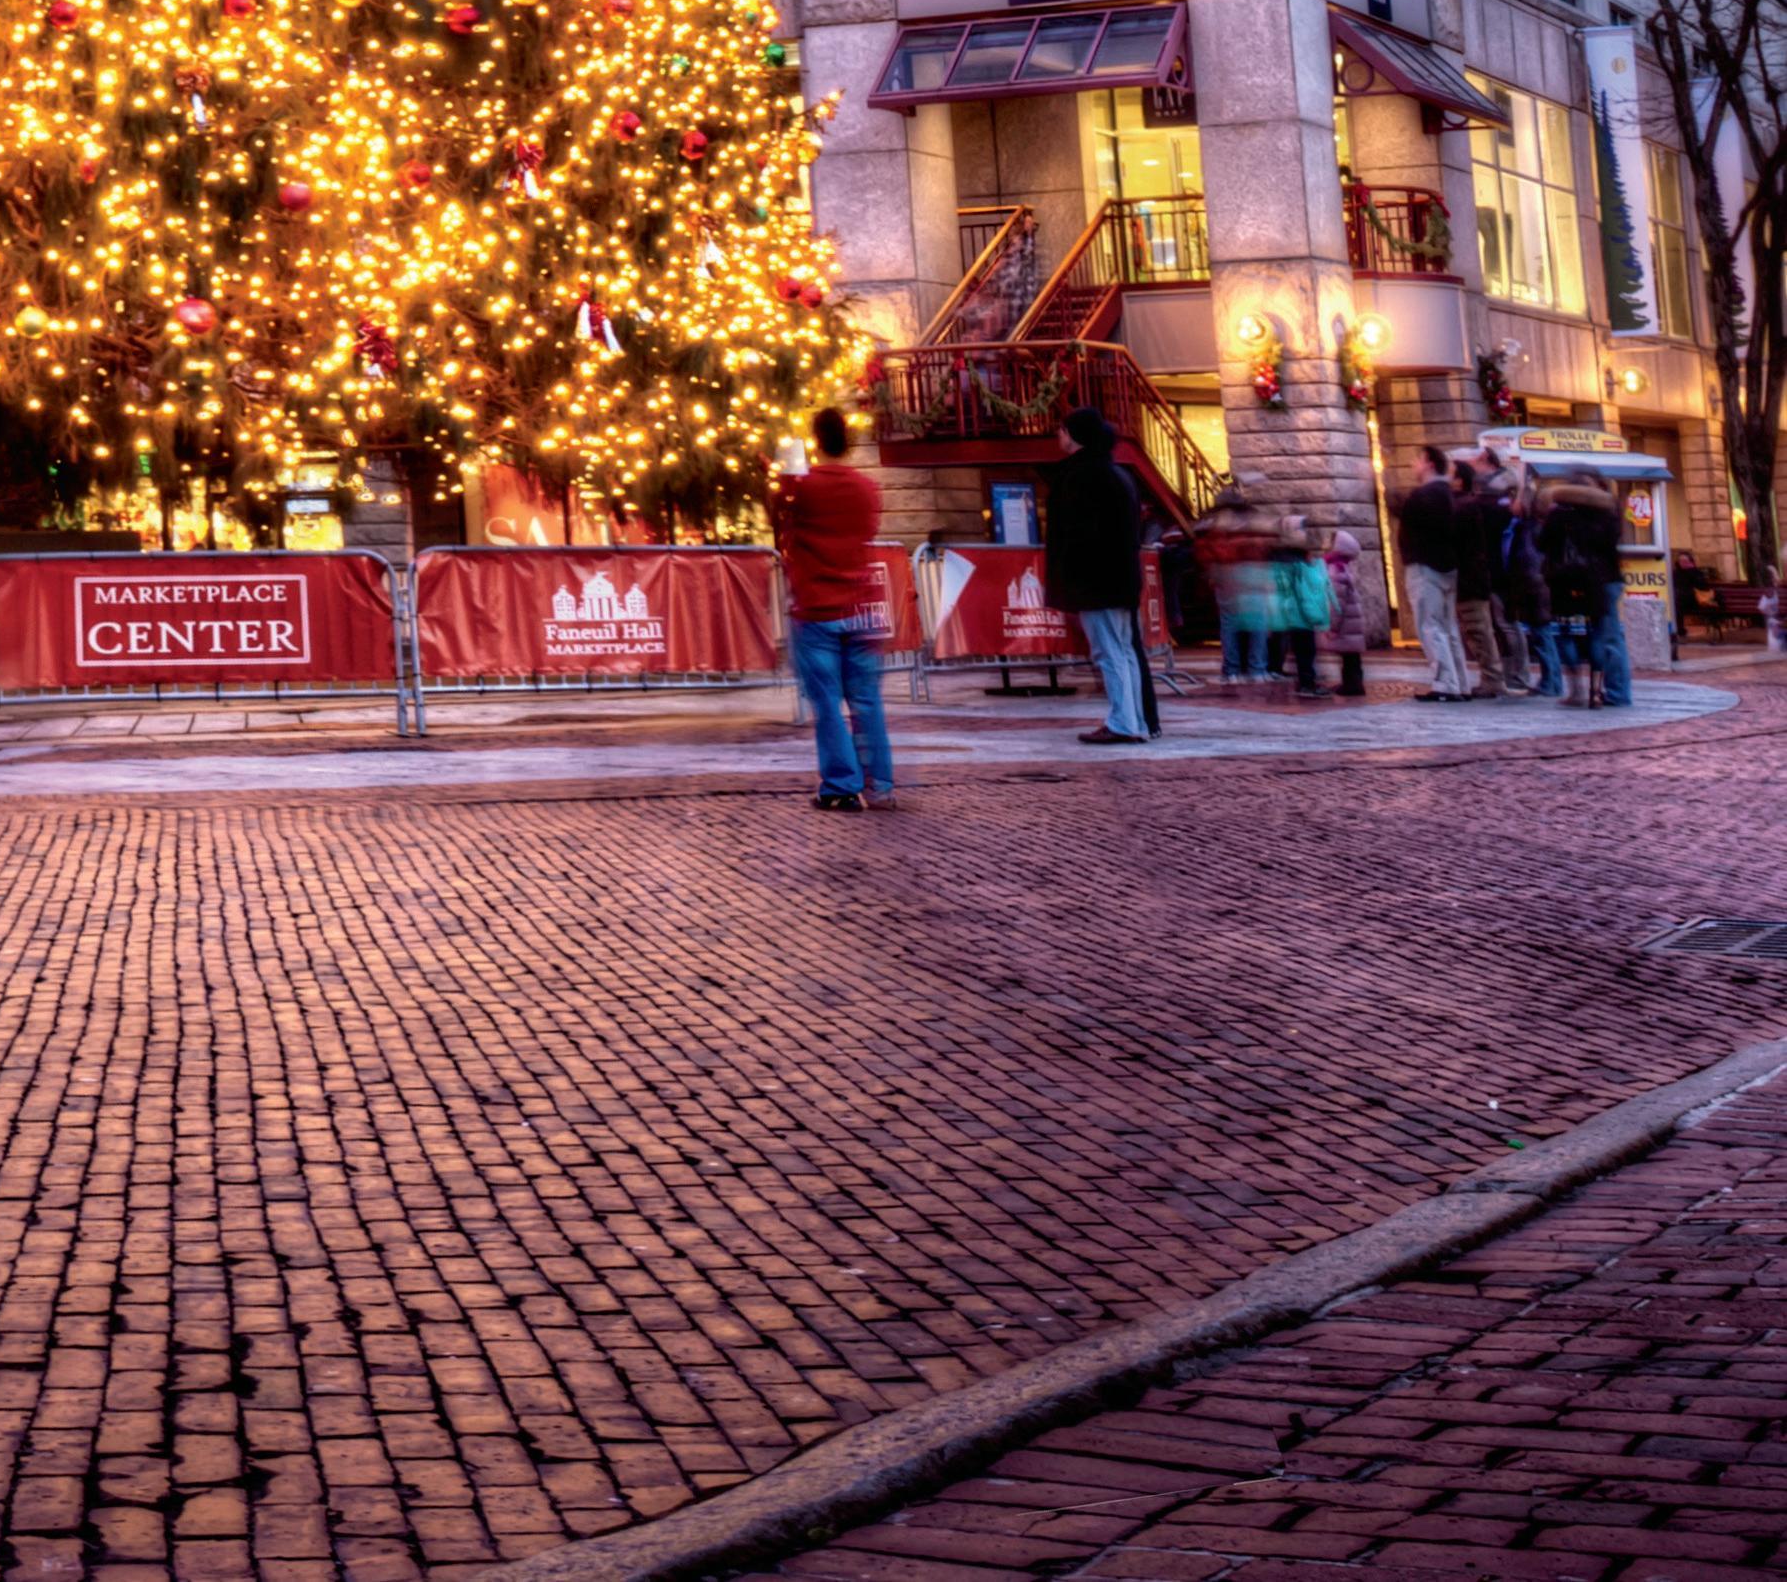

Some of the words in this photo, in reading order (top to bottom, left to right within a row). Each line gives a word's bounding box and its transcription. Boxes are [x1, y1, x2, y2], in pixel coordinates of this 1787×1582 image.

[1550, 431, 1597, 441] TROLLEY
[1557, 441, 1593, 451] TOURS
[94, 584, 288, 605] MARKETPLACE
[87, 620, 300, 655] CENTER
[544, 623, 618, 642] Faneuil
[621, 621, 664, 639] Hall
[546, 641, 666, 655] MARKETPLACE
